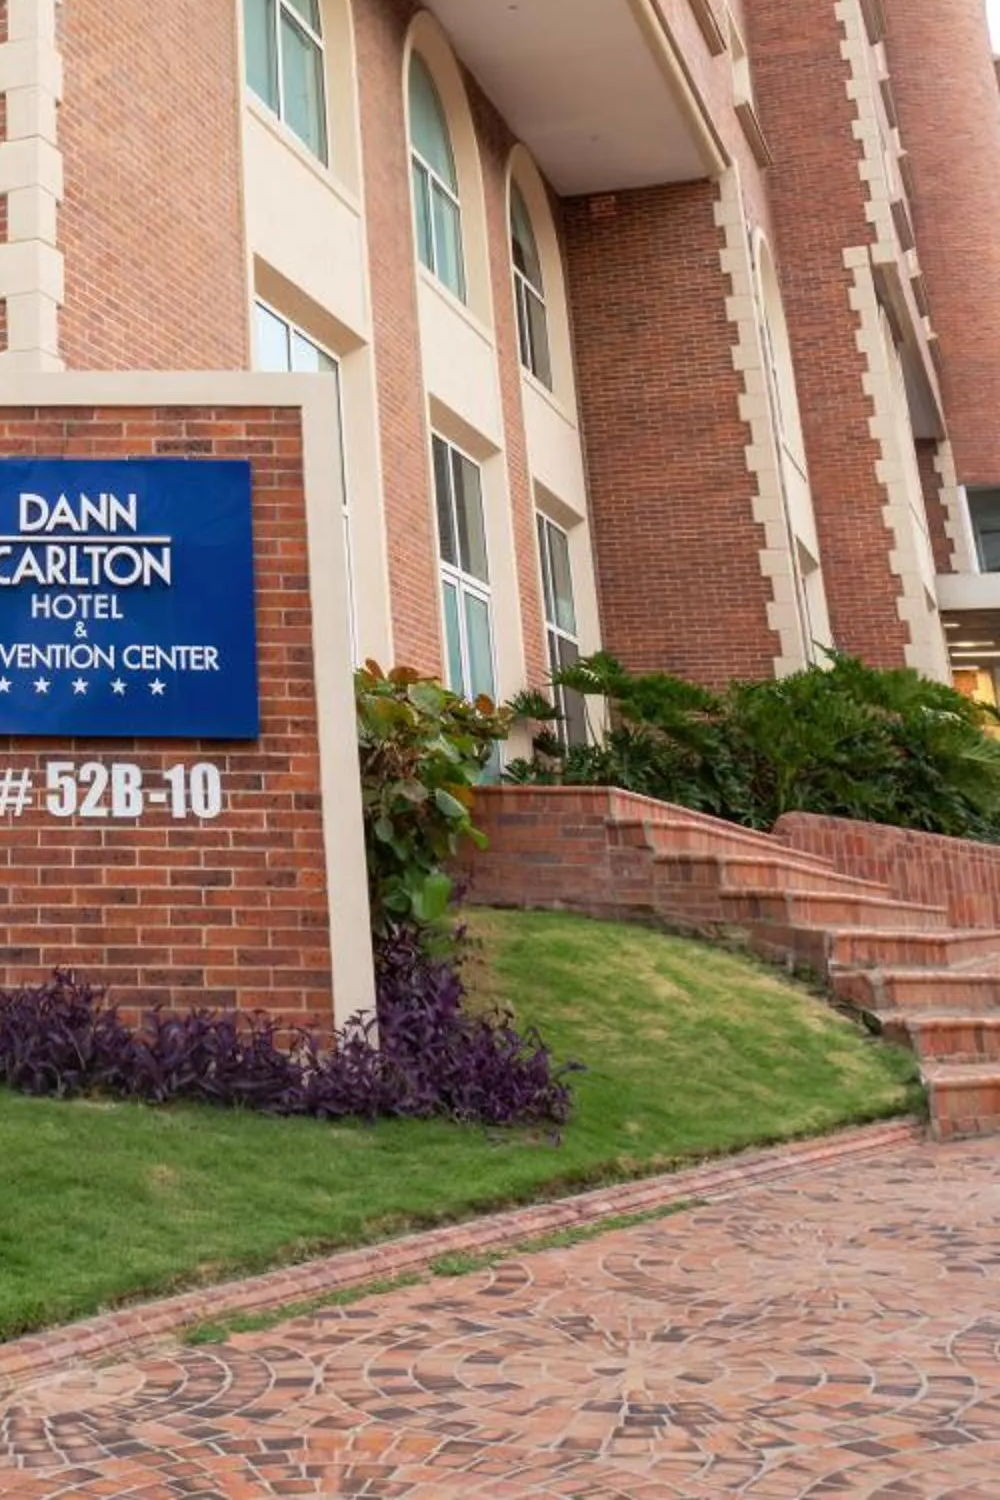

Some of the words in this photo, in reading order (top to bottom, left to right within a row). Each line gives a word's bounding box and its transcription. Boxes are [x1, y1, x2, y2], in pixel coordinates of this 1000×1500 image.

[17, 492, 137, 533] DANN
[30, 594, 124, 621] HOTEL
[73, 620, 89, 638] &
[122, 643, 221, 671] CENTER
[45, 761, 222, 819] 52B-10
